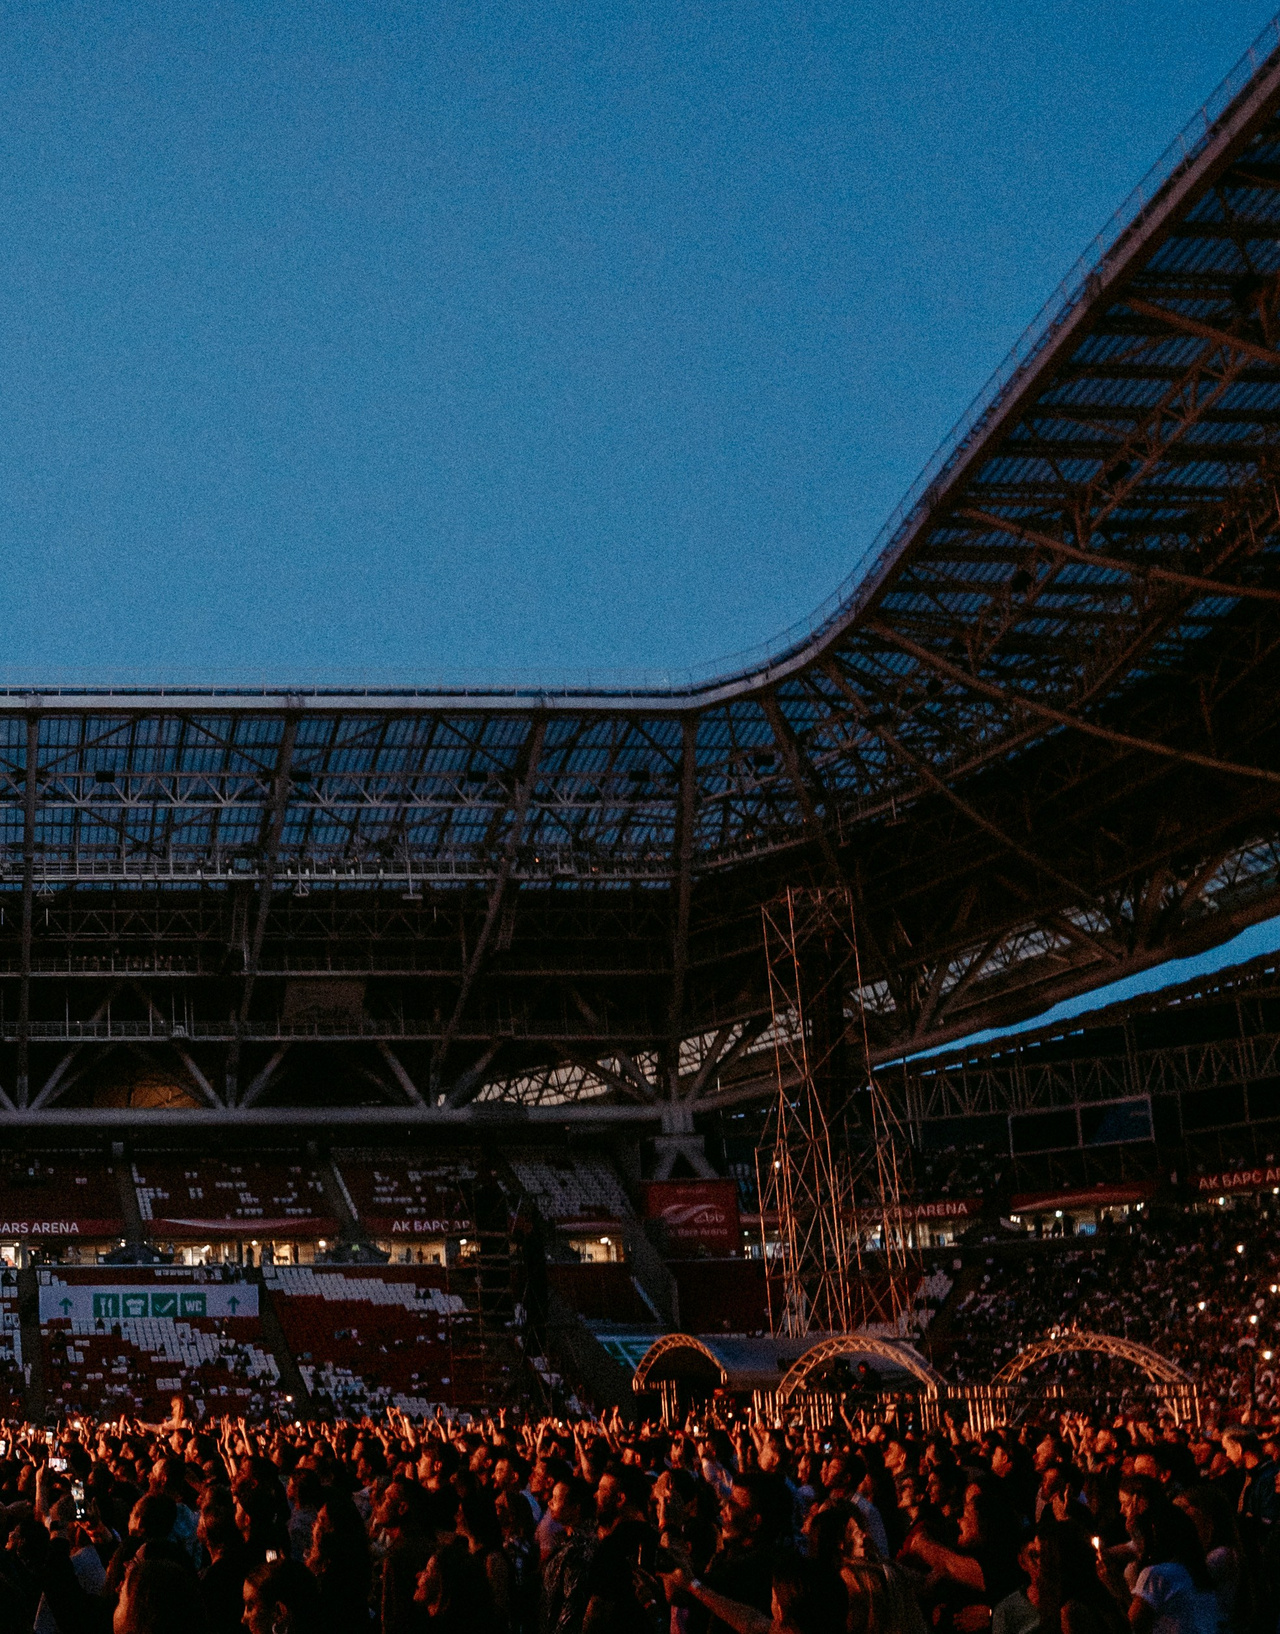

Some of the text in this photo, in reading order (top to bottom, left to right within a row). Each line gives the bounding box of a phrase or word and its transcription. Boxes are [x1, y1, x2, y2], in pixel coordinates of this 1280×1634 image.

[1222, 1169, 1262, 1188] БАРС
[916, 1202, 968, 1218] ARENA
[31, 1222, 80, 1234] ARENA
[391, 1220, 410, 1232] АК
[184, 1300, 202, 1312] WC
